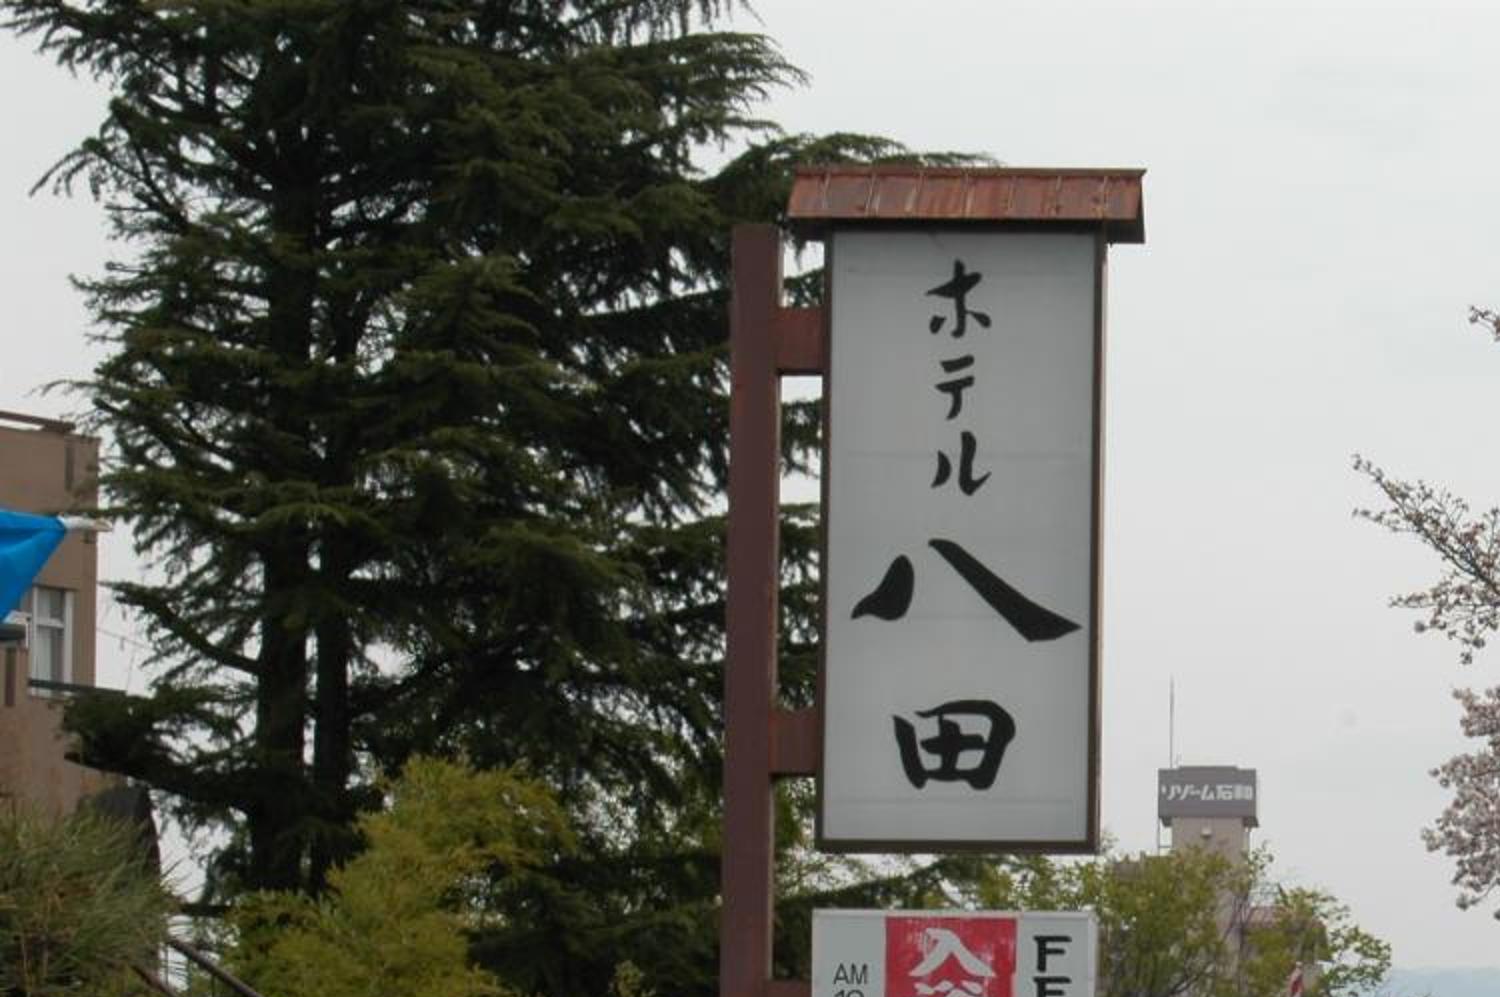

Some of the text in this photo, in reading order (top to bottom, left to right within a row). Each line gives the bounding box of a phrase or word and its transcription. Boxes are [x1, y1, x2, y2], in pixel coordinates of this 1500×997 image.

[850, 259, 1083, 790] ホテル八田
